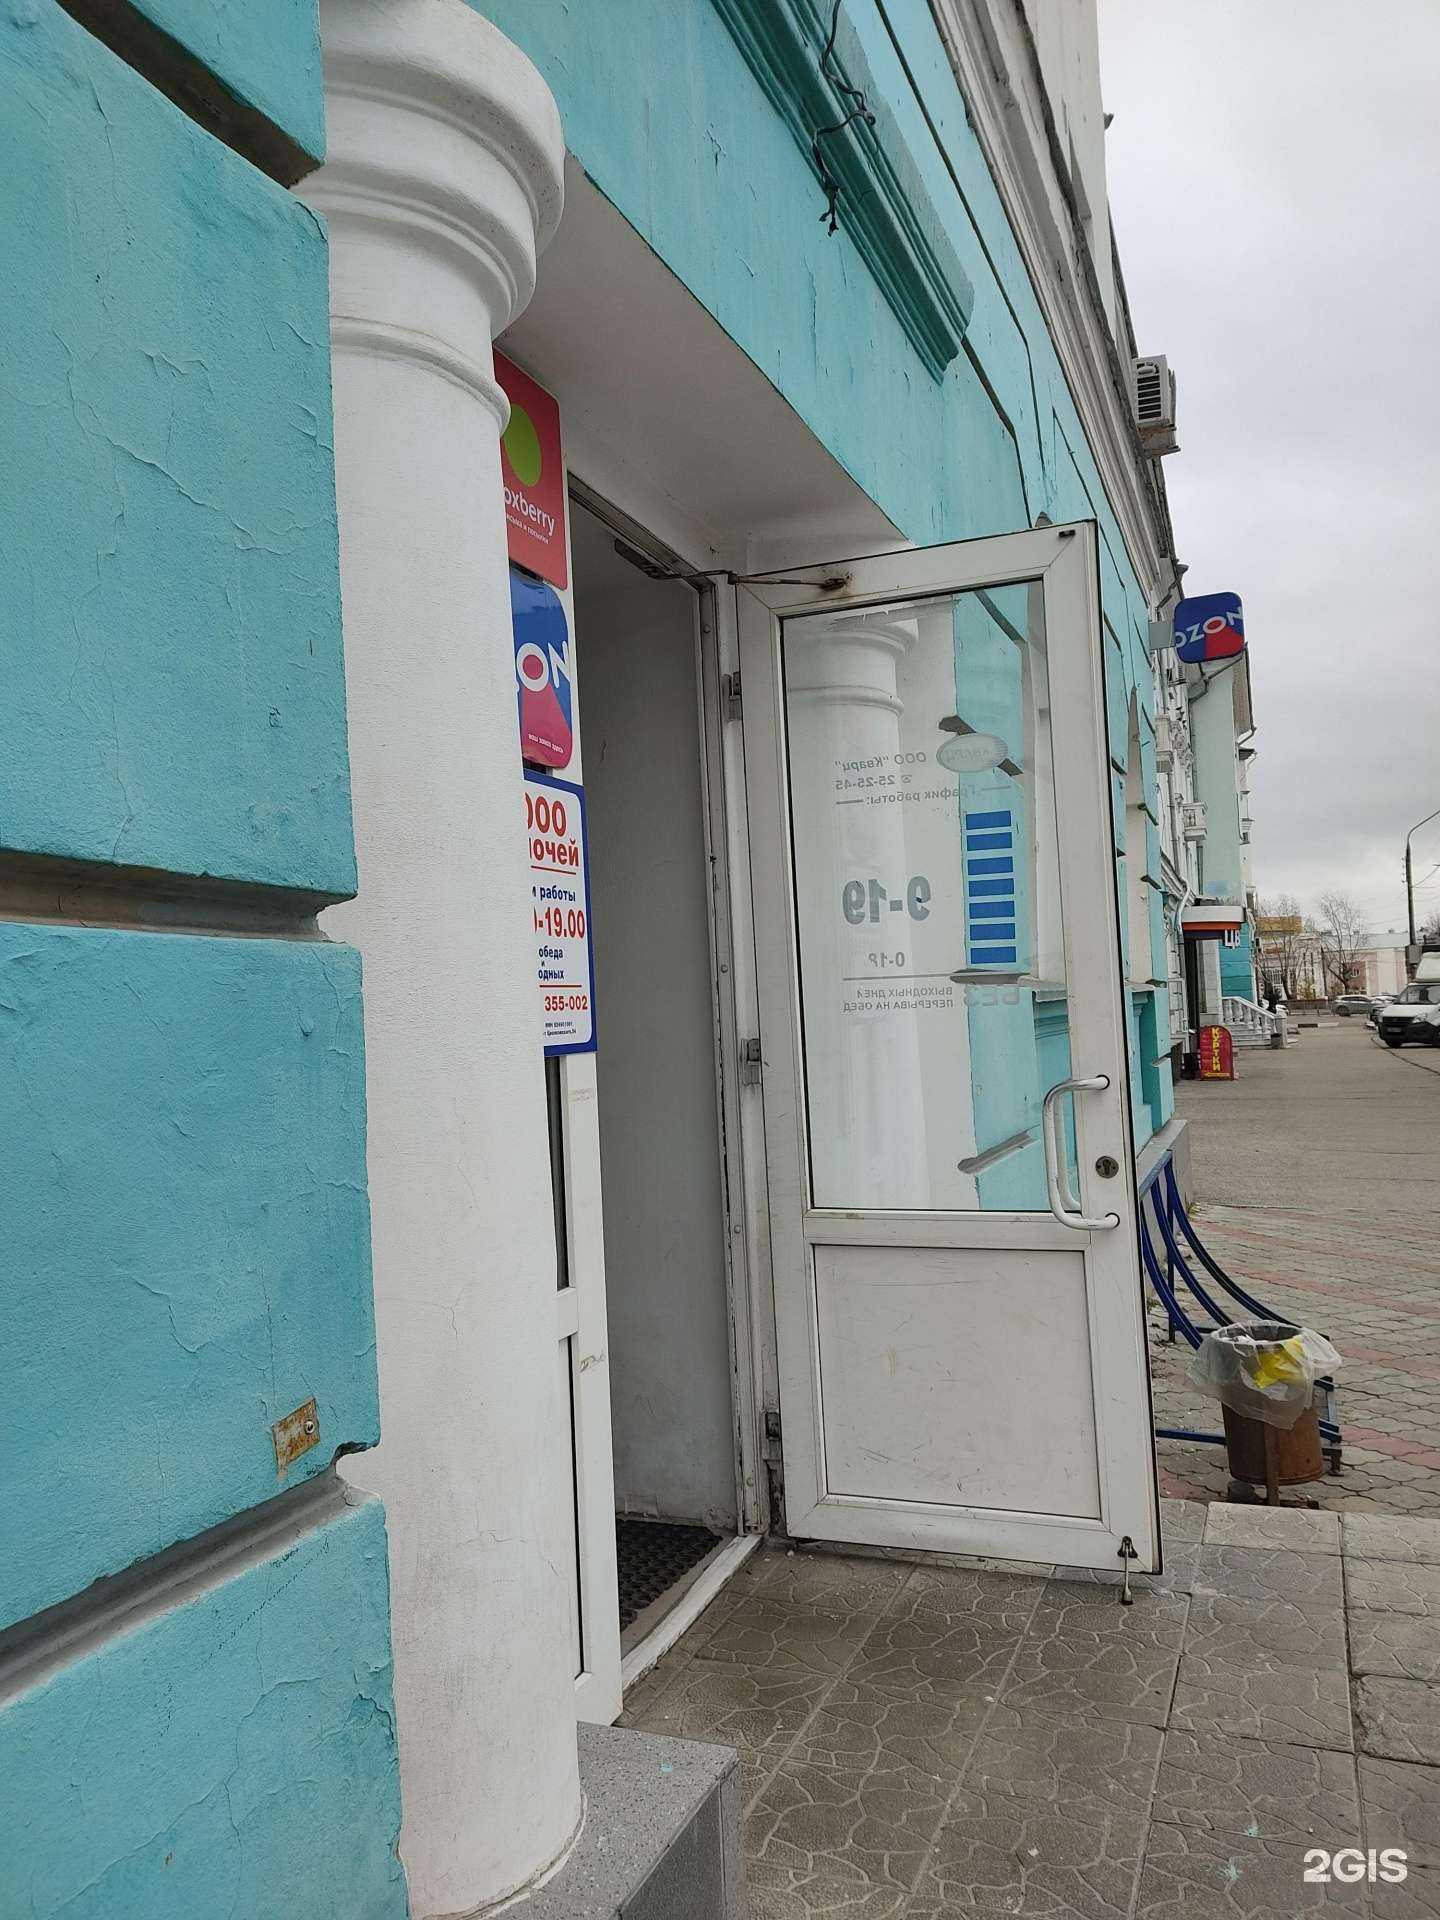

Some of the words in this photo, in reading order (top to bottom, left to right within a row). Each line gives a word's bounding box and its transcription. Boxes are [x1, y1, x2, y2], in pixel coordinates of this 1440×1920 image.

[1175, 606, 1243, 648] OZON
[515, 640, 571, 692] ON
[539, 884, 576, 902] работы
[538, 945, 563, 960] обеда
[538, 968, 565, 981] одных
[544, 995, 588, 1011] 355-002
[1211, 1027, 1221, 1072] КУРТКИ
